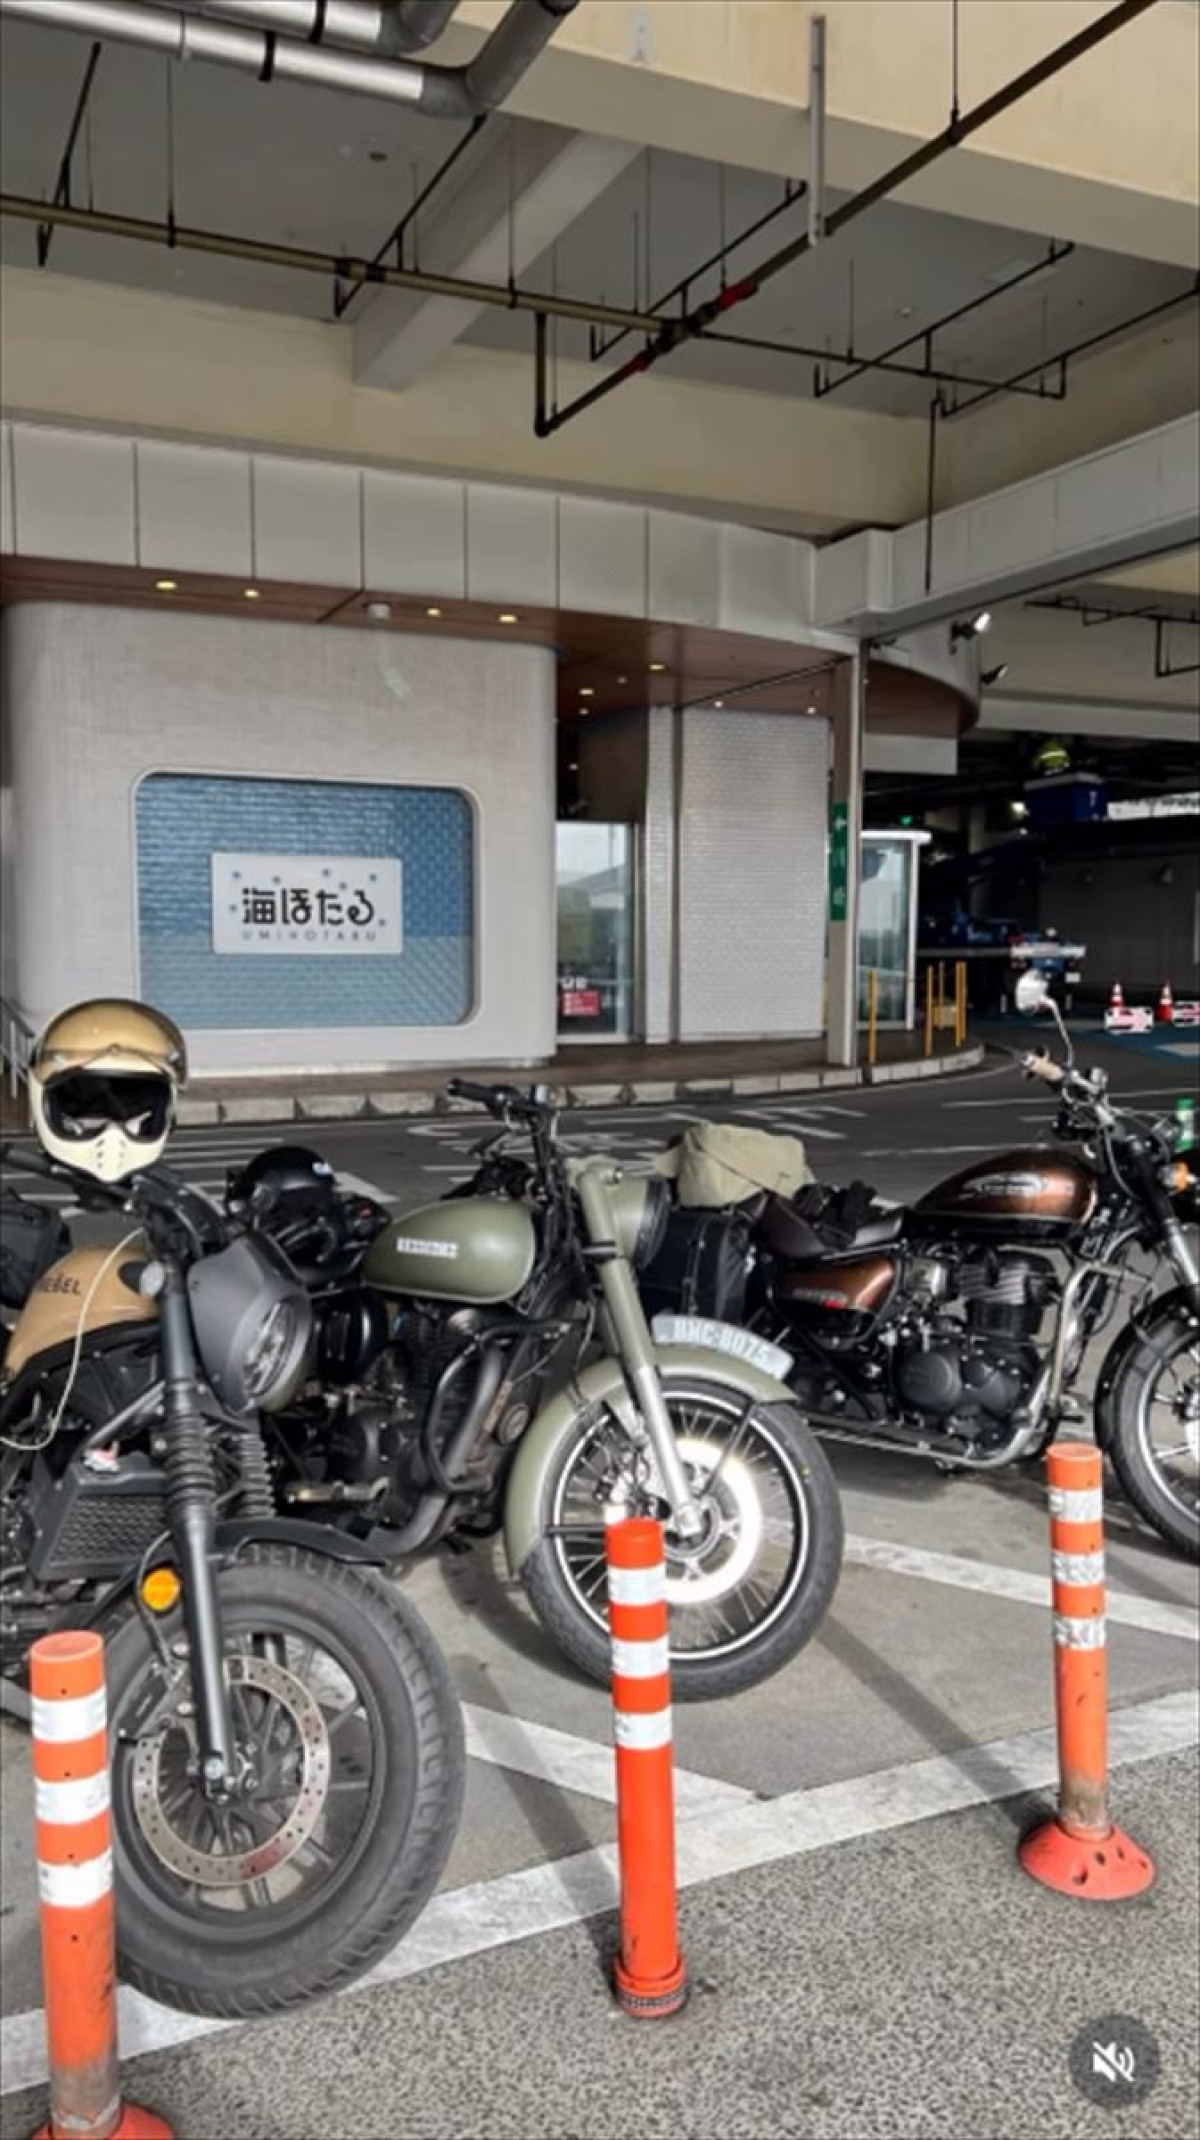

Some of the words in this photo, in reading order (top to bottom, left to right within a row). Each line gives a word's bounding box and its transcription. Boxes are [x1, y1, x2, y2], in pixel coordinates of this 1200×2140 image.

[242, 888, 375, 926] 海ほたる
[242, 930, 377, 942] UMIHOTARU
